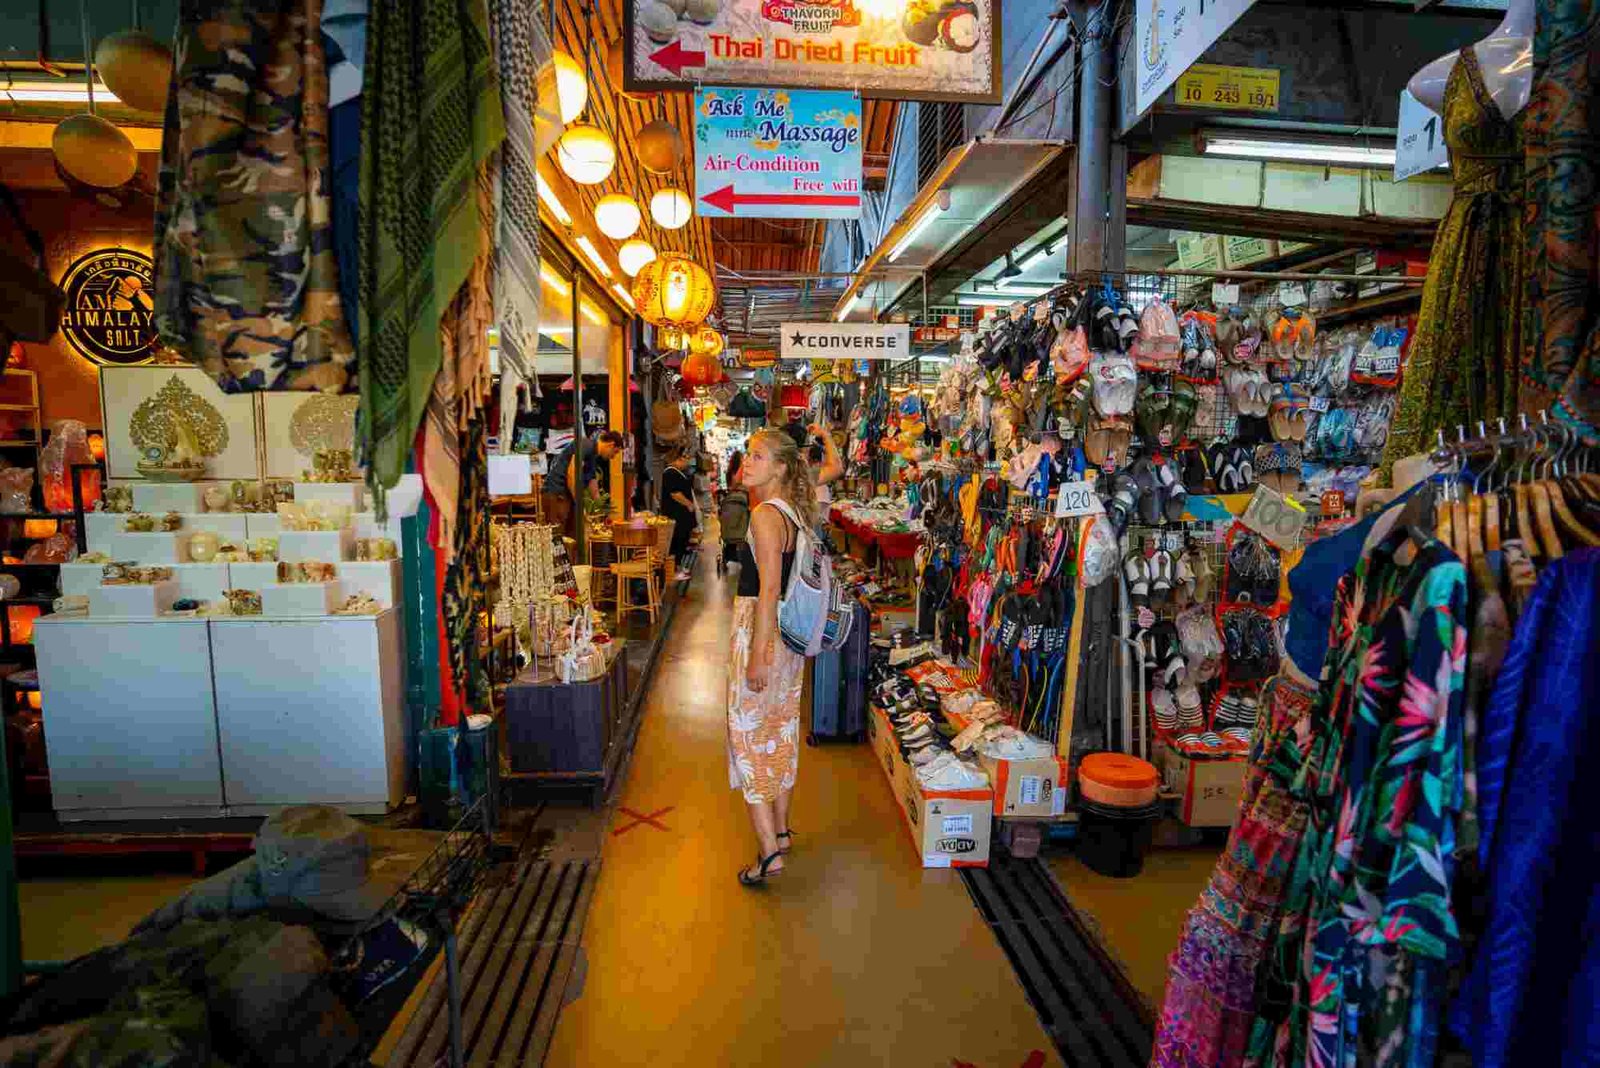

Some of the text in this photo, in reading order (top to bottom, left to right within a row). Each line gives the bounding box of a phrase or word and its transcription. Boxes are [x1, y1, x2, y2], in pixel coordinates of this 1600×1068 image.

[781, 7, 840, 19] THAVORN
[794, 20, 832, 31] FRUIT
[709, 35, 920, 65] Thai Dried Fruit
[1184, 87, 1275, 108] 10 243 19/1
[709, 96, 784, 117] Ask Me
[760, 120, 858, 152] Massage
[704, 155, 820, 172] Air-Condition
[793, 177, 858, 191] Free wifi
[62, 310, 154, 327] HIMALAY
[106, 329, 140, 346] SALT
[808, 335, 897, 348] CONVERSE
[1065, 491, 1091, 511] 120
